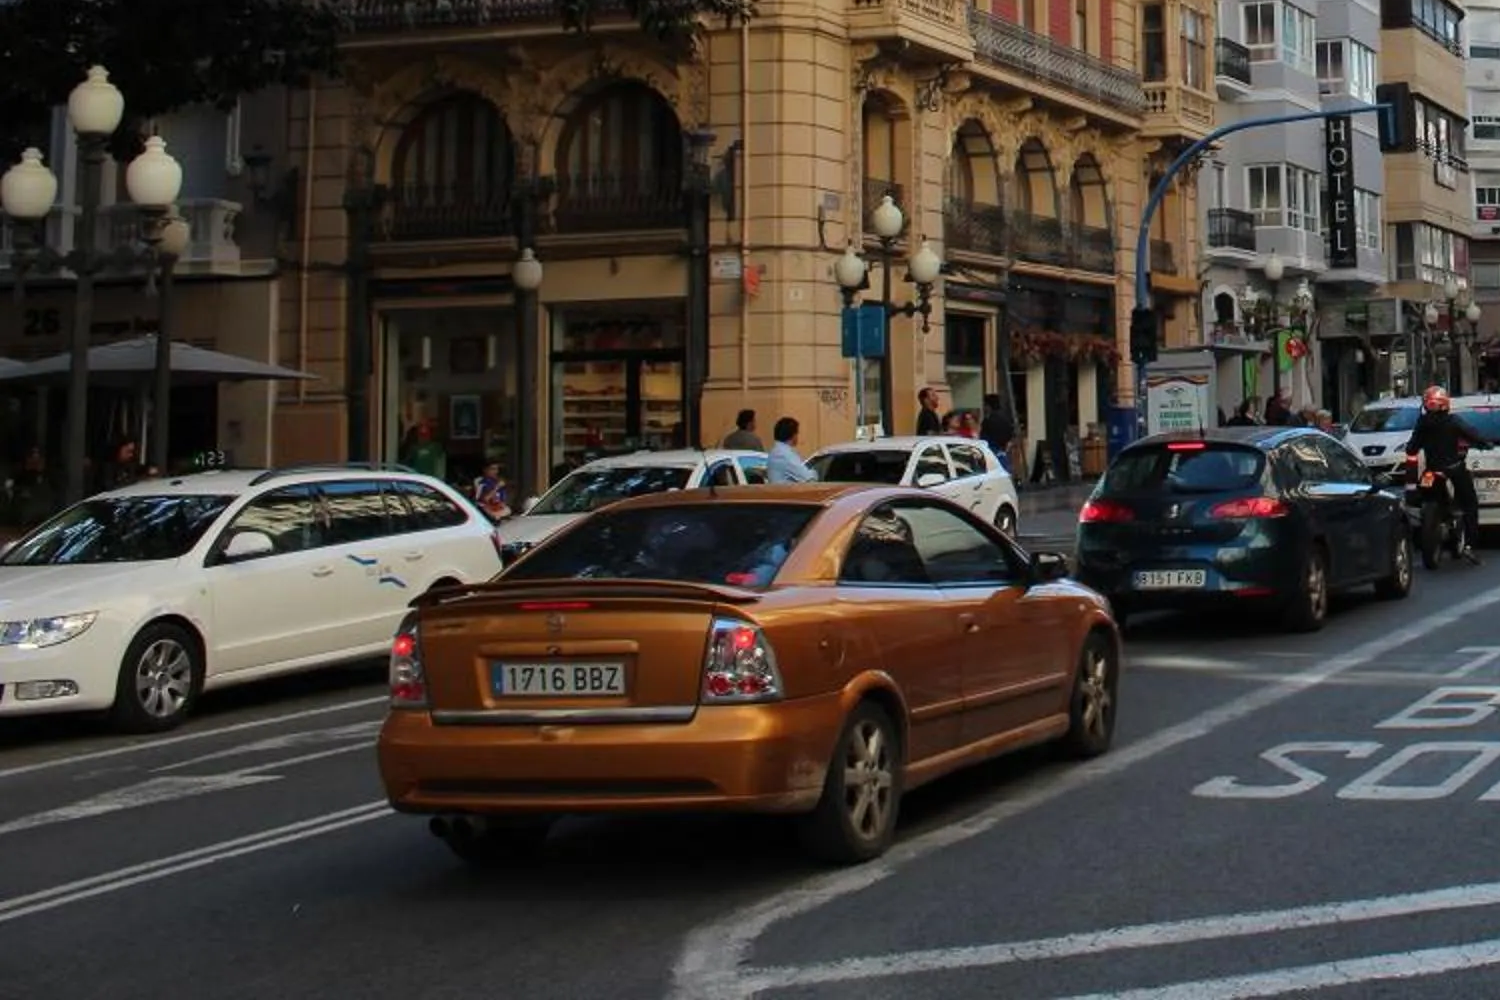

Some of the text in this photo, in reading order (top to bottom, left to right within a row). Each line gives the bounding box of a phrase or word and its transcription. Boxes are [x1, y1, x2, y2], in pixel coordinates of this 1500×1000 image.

[1329, 119, 1348, 251] HOTEL
[509, 667, 619, 691] 1716 BBZ
